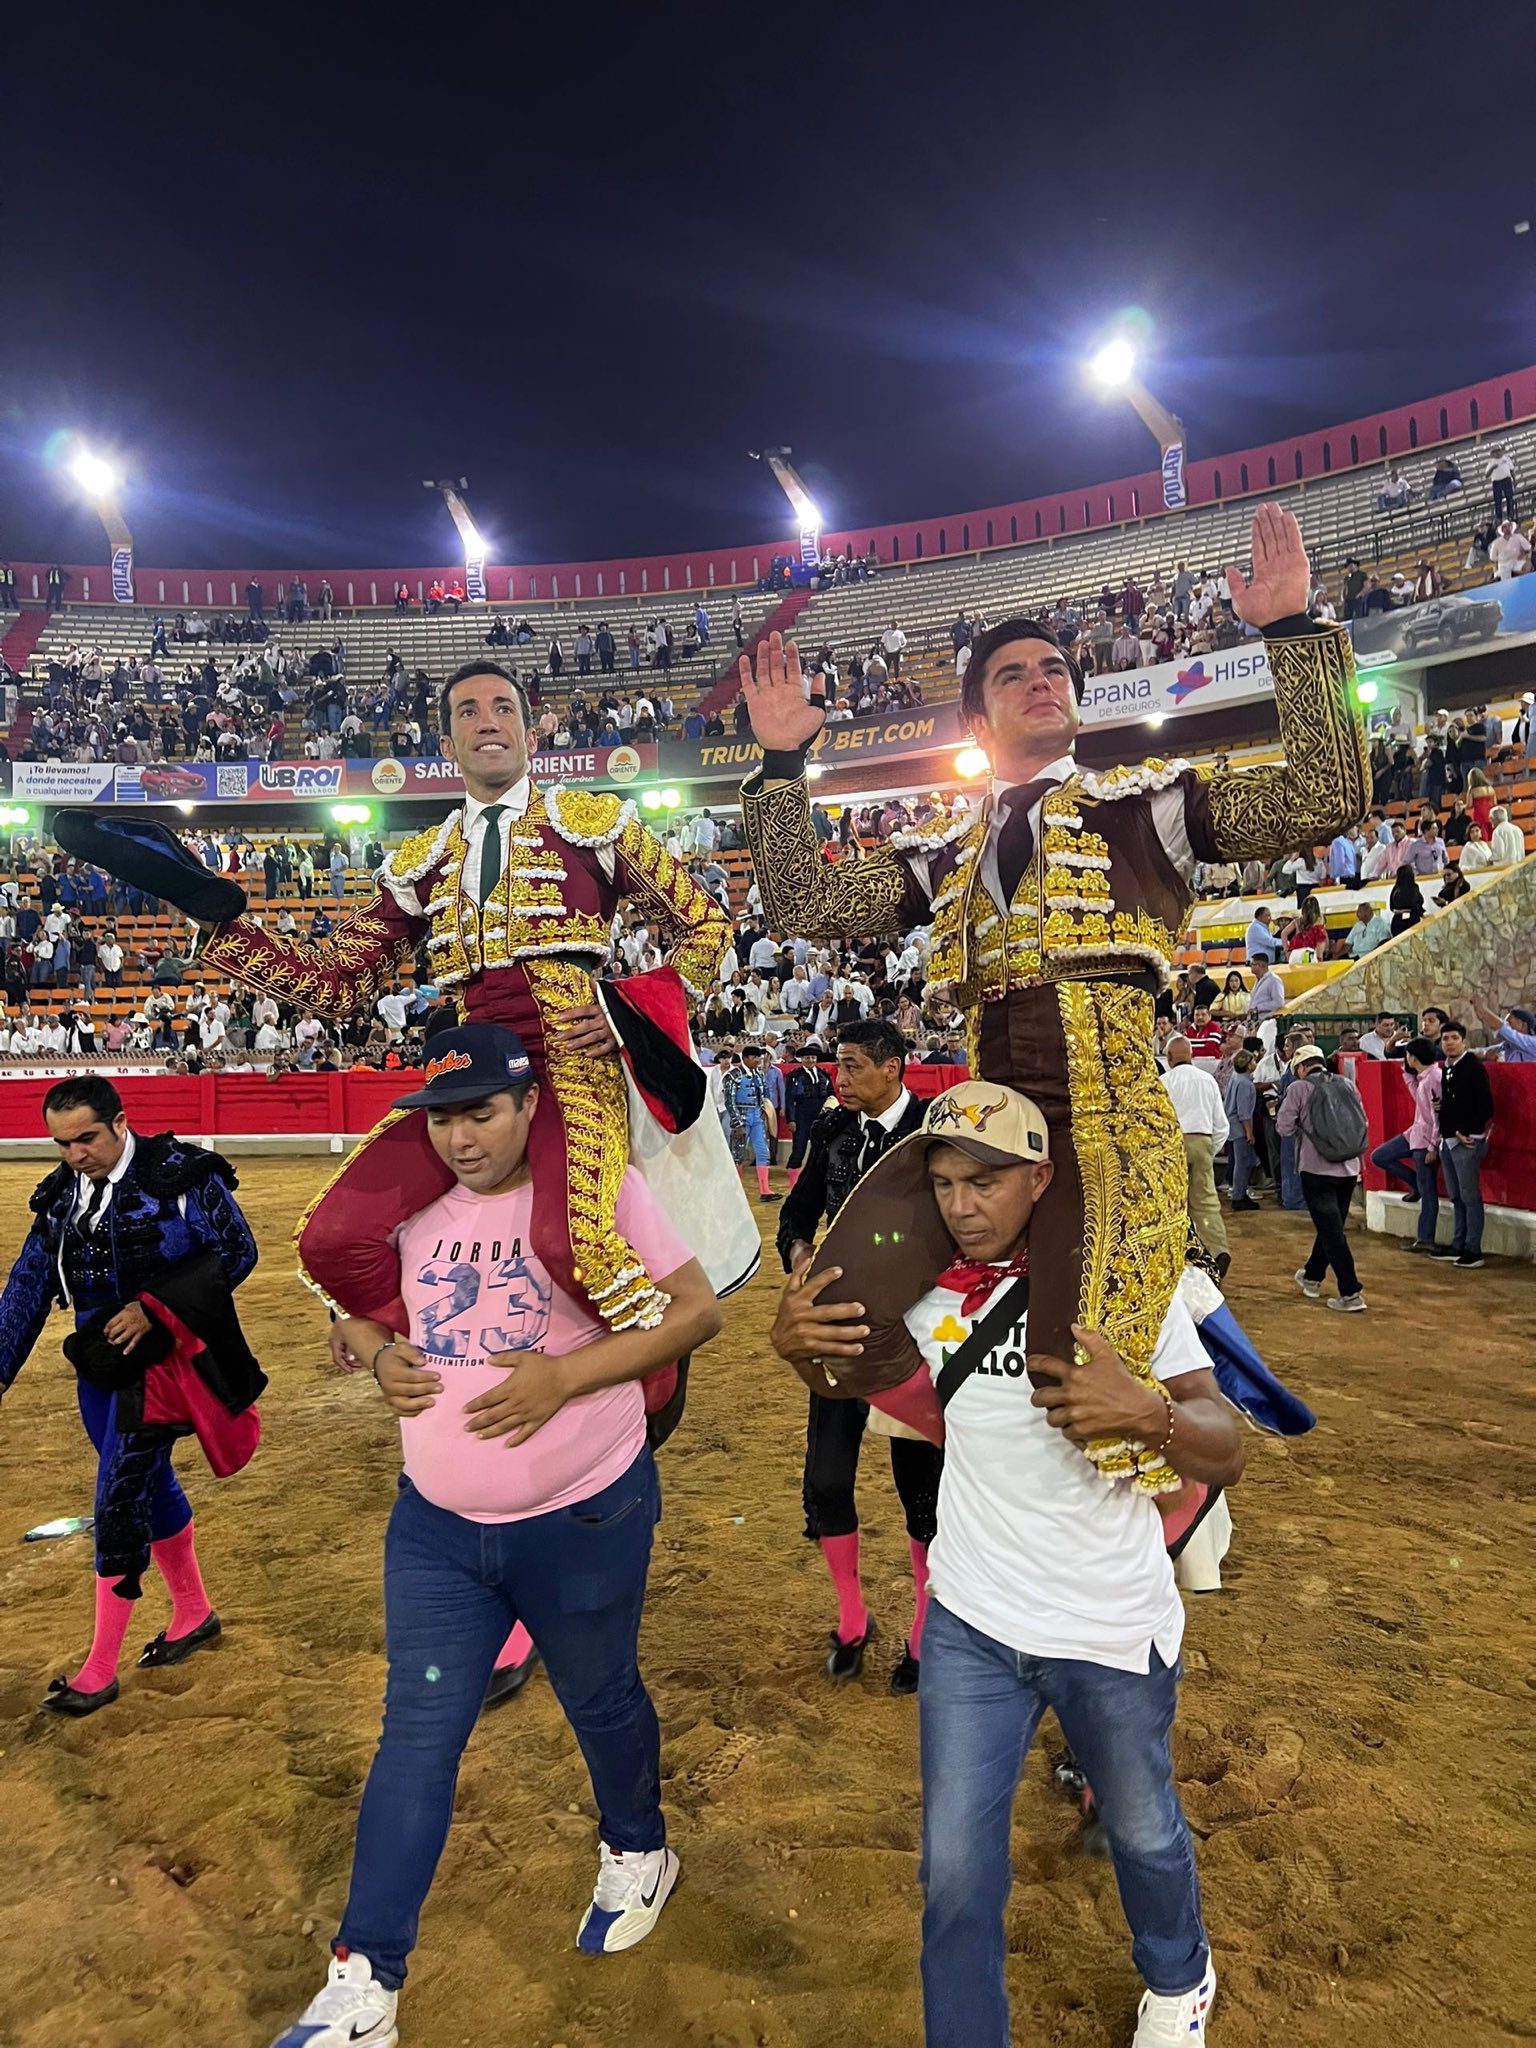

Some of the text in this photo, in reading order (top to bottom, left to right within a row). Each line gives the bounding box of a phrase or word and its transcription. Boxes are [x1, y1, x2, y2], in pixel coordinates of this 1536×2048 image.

[1163, 446, 1186, 507] POLAR
[113, 551, 134, 601] POLAR
[467, 557, 487, 600] POLA
[1215, 654, 1271, 683] HISP
[834, 717, 935, 751] BET.COM
[26, 776, 56, 784] donde
[57, 776, 102, 785] necesites
[374, 777, 402, 785] ORIENTE
[609, 765, 638, 774] ORIENTE
[32, 786, 72, 797] cualquier
[74, 786, 93, 795] hora
[416, 1256, 553, 1358] 23
[974, 1350, 1025, 1378] LLO
